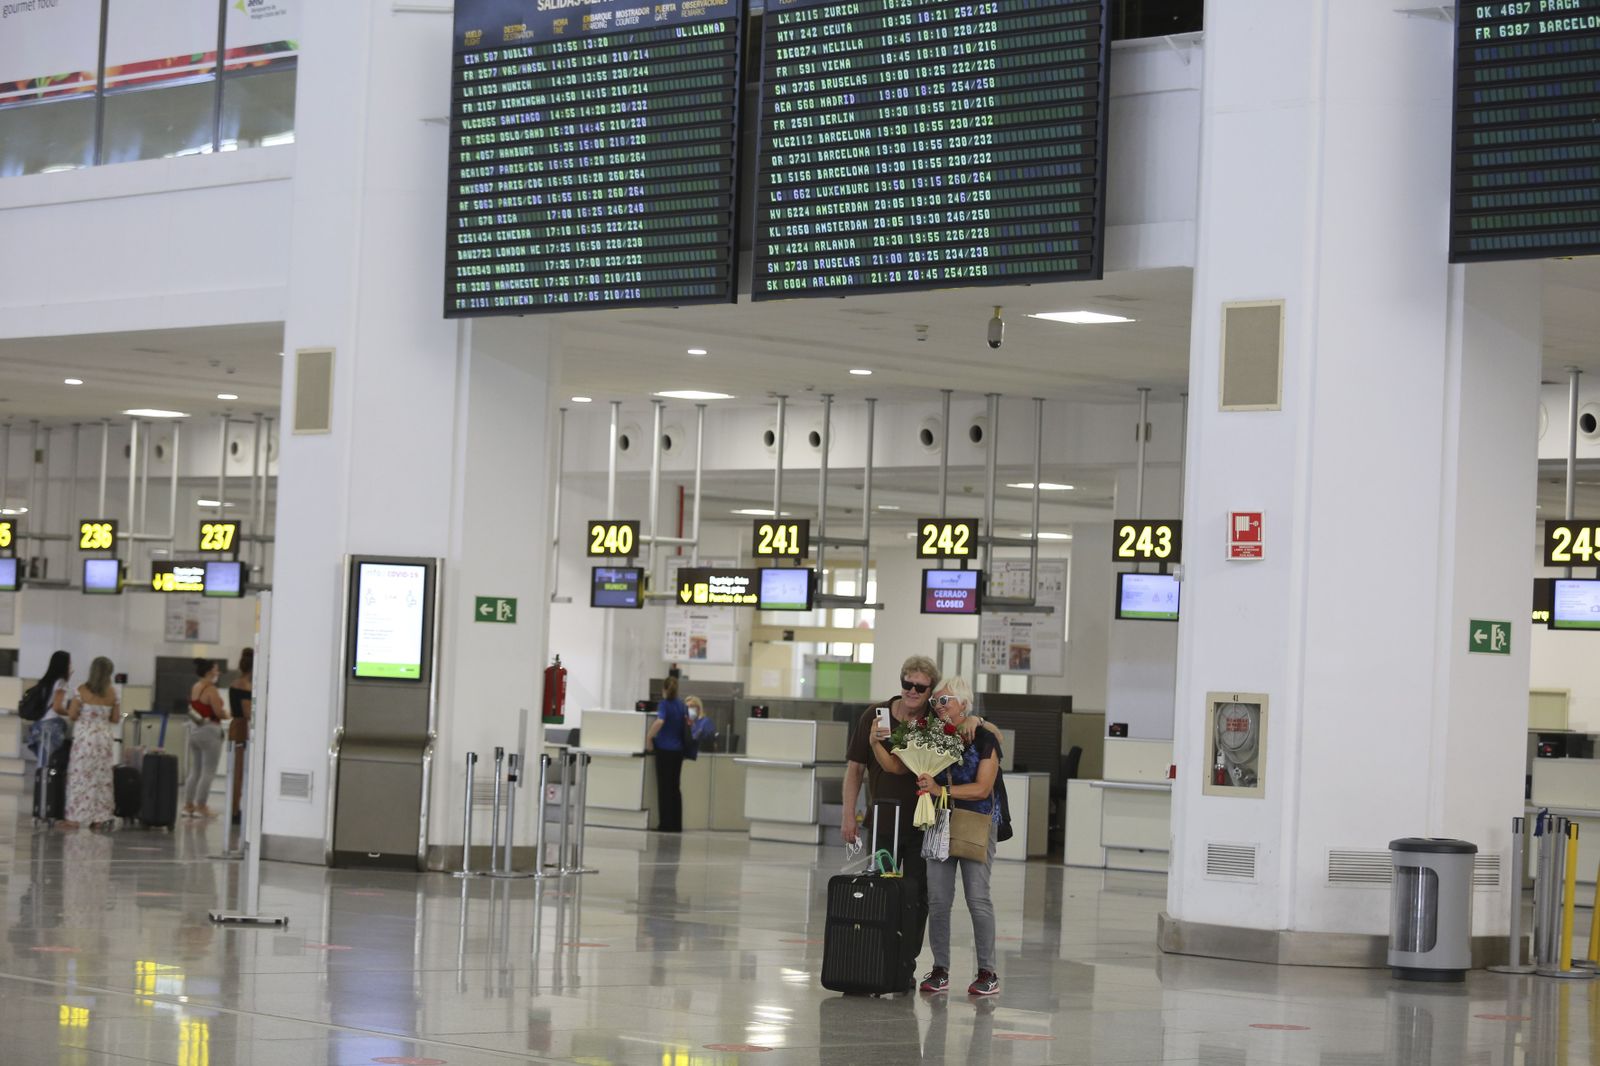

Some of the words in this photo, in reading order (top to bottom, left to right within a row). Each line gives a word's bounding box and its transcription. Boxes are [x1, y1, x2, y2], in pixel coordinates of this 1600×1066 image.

[777, 30, 794, 42] HTY
[800, 27, 817, 39] 242
[823, 22, 852, 36] CEUTA
[881, 15, 911, 28] 18:35
[917, 10, 948, 24] 18:21
[954, 4, 997, 19] 252/252
[778, 13, 789, 24] LX
[795, 9, 818, 22] 2115
[824, 4, 858, 18] ZURICH
[1476, 6, 1492, 18] OK
[1500, 2, 1531, 15] 4697
[822, 39, 863, 54] MELILLA
[881, 33, 910, 46] 18:45
[917, 28, 947, 42] 18:10
[1475, 27, 1491, 40] FR
[1499, 23, 1530, 37] 6387
[776, 66, 787, 77] FR
[799, 62, 816, 74] 591
[821, 58, 850, 71] VIENA
[880, 51, 910, 65] 18:45
[916, 47, 946, 60] 18:10
[952, 41, 996, 56] 210/216
[775, 83, 786, 94] SN
[792, 80, 815, 92] 3736
[821, 74, 867, 89] BRUSELAS
[879, 69, 909, 83] 19:00
[952, 59, 995, 74] 222/226
[774, 100, 791, 112] AEA
[820, 93, 855, 107] MADRID
[878, 88, 908, 101] 19:00
[774, 119, 785, 130] FR
[791, 116, 814, 128] 2591
[819, 111, 854, 125] BERLIN
[878, 106, 908, 119] 19:30
[914, 102, 944, 115] 18:55
[950, 97, 994, 111] 210/216
[819, 128, 871, 143] BARCELONA
[877, 124, 907, 137] 19:30
[913, 120, 943, 133] 18:55
[949, 115, 993, 130] 230/232
[789, 151, 812, 163] 3731
[818, 146, 870, 161] BARCELONA
[876, 142, 906, 155] 19:30
[912, 139, 943, 152] 18:55
[949, 134, 992, 148] 230/232
[772, 172, 783, 183] IB
[789, 169, 811, 181] 5156
[817, 164, 870, 178] BARCELONA
[876, 160, 905, 173] 19:30
[911, 157, 942, 170] 18:55
[948, 152, 991, 167] 230/232
[771, 190, 782, 200] LG
[794, 187, 811, 198] 662
[816, 182, 869, 196] LUXEMBURG
[875, 179, 905, 191] 19:50
[911, 175, 941, 188] 19:15
[947, 171, 991, 185] 260/264
[787, 205, 810, 216] 6224
[816, 200, 868, 214] AMSTERDAM
[874, 197, 904, 209] 20:05
[910, 194, 940, 206] 19:30
[947, 190, 990, 203] 246/250
[770, 225, 781, 236] KL
[786, 223, 809, 234] 2650
[815, 218, 867, 232] AMSTERDAM
[873, 215, 903, 227] 20:05
[909, 212, 940, 225] 19:30
[946, 208, 989, 222] 246/250
[769, 243, 780, 253] DY
[786, 240, 809, 252] 4224
[814, 237, 855, 250] ARLANDA
[873, 233, 903, 246] 20:30
[909, 231, 939, 243] 19:55
[768, 260, 779, 271] SN
[814, 255, 860, 268] BRUSELAS
[872, 252, 902, 264] 21:00
[908, 249, 938, 261] 20:25
[767, 278, 779, 288] SK
[813, 273, 854, 286] ARLANDA
[871, 270, 901, 282] 21:20
[907, 268, 937, 280] 20:45
[80, 523, 112, 549] 236
[200, 524, 236, 550] 237
[590, 524, 633, 554] 240
[758, 524, 800, 554] 241
[922, 524, 970, 554] 242
[1118, 525, 1172, 558] 243
[934, 590, 968, 598] CERRADO
[936, 600, 964, 608] CLOSED
